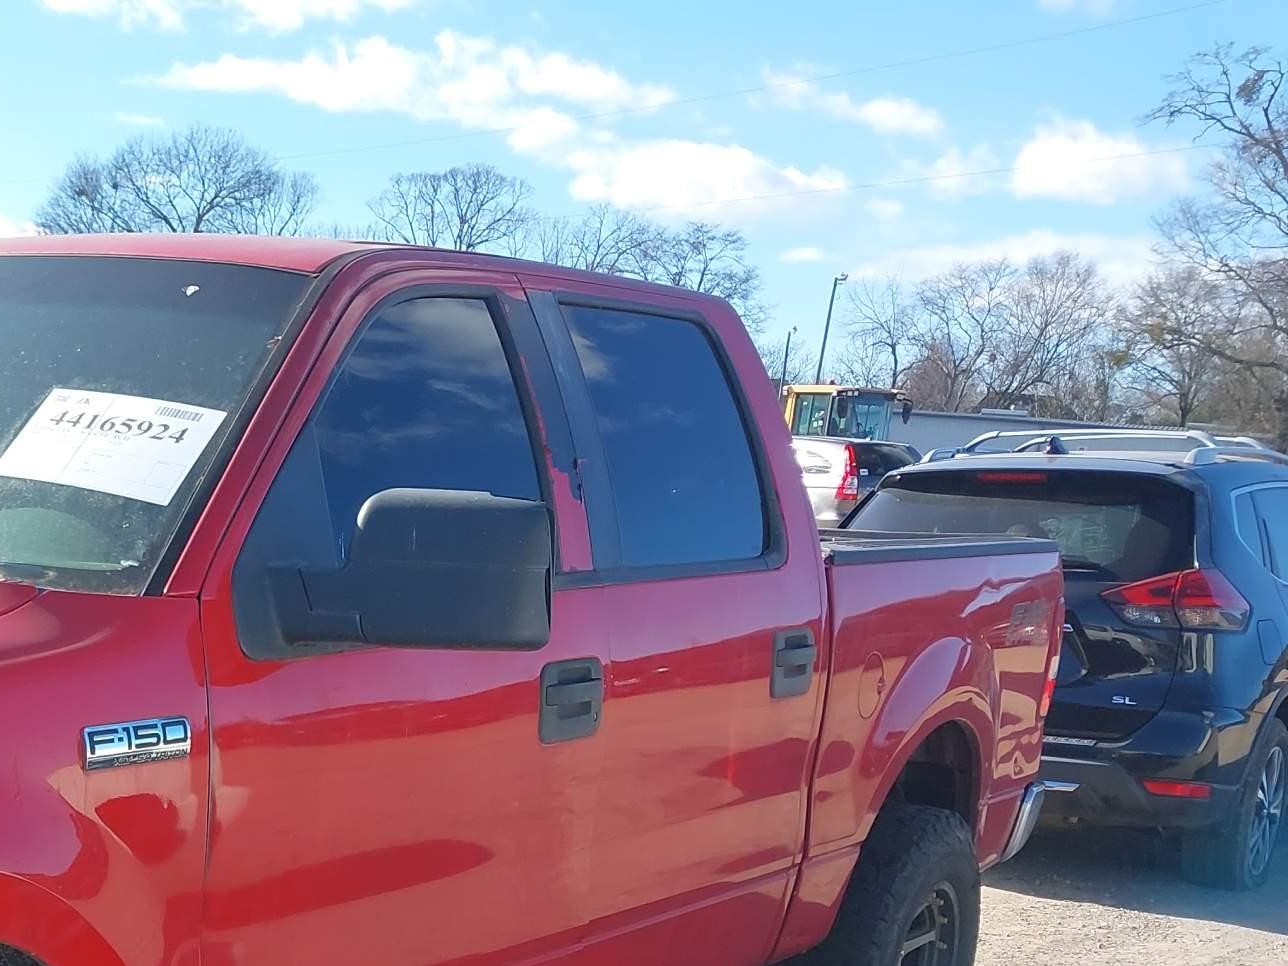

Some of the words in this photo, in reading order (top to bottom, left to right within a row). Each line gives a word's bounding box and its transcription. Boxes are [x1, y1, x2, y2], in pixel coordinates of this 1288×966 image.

[49, 410, 190, 444] 44165924
[1111, 695, 1137, 705] SL
[87, 719, 189, 756] F-150
